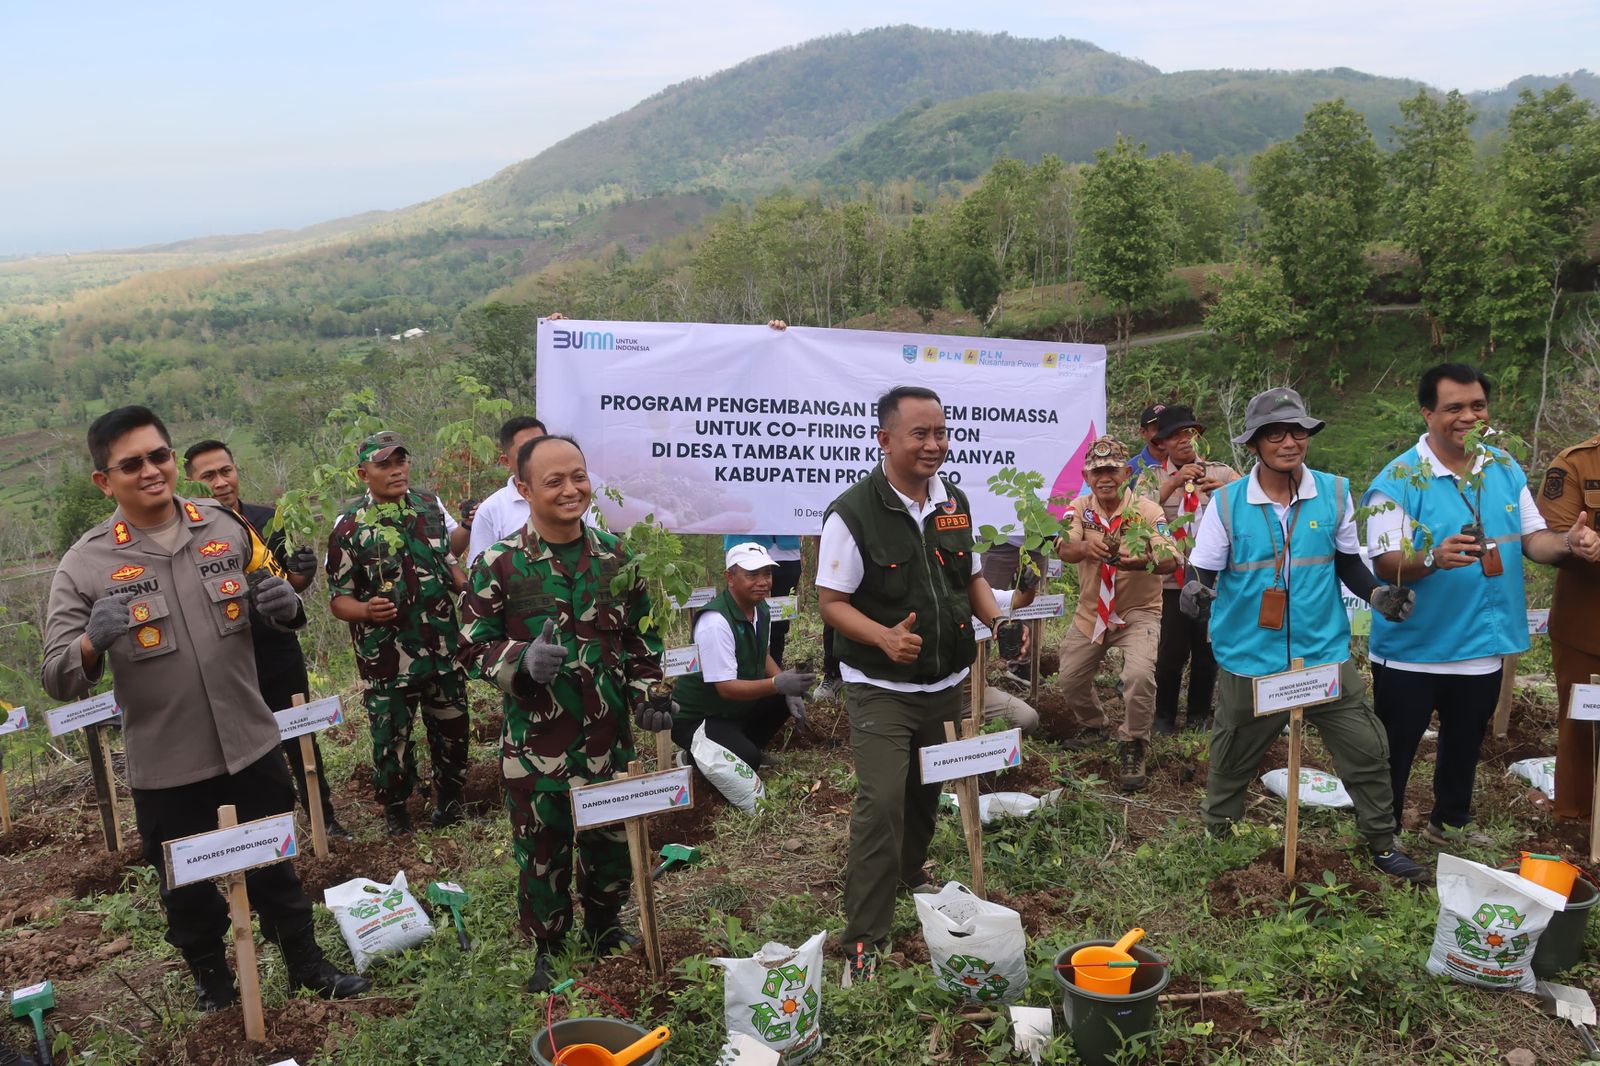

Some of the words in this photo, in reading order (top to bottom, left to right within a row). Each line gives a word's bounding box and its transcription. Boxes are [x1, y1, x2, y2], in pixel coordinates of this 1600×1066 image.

[938, 351, 962, 361] PLN
[980, 350, 1003, 359] PLN
[1058, 353, 1082, 362] PLN
[978, 357, 1016, 367] Nusantara
[1016, 359, 1040, 368] Power
[600, 394, 702, 412] PROGRAM
[706, 397, 866, 417] PENGEMBANGAN
[971, 406, 1059, 424] BIOMASSA
[695, 420, 762, 437] UNTUK
[766, 422, 866, 439] CO-FIRING
[652, 442, 671, 458] DI
[676, 443, 727, 458] DESA
[731, 443, 815, 460] TAMBAK
[820, 446, 861, 461] UKIR
[715, 466, 831, 483] KABUPATEN
[794, 508, 803, 517] 10
[805, 508, 823, 517] Des
[940, 516, 966, 527] BPBD
[201, 557, 240, 577] POLRI
[1279, 683, 1295, 691] SENIOR
[1295, 679, 1318, 688] MANAGER
[1284, 686, 1312, 697] NUSANTARA
[297, 715, 334, 729] PROBOLINGGO
[942, 756, 964, 766] BUPATI
[964, 748, 1007, 761] PROBOLINGGO
[582, 798, 611, 809] DANDIM
[611, 795, 630, 803] 0820
[630, 785, 680, 800] PROBOLINGGO
[186, 848, 225, 865] KAPOLRES
[225, 836, 279, 855] PROBOLINGGO
